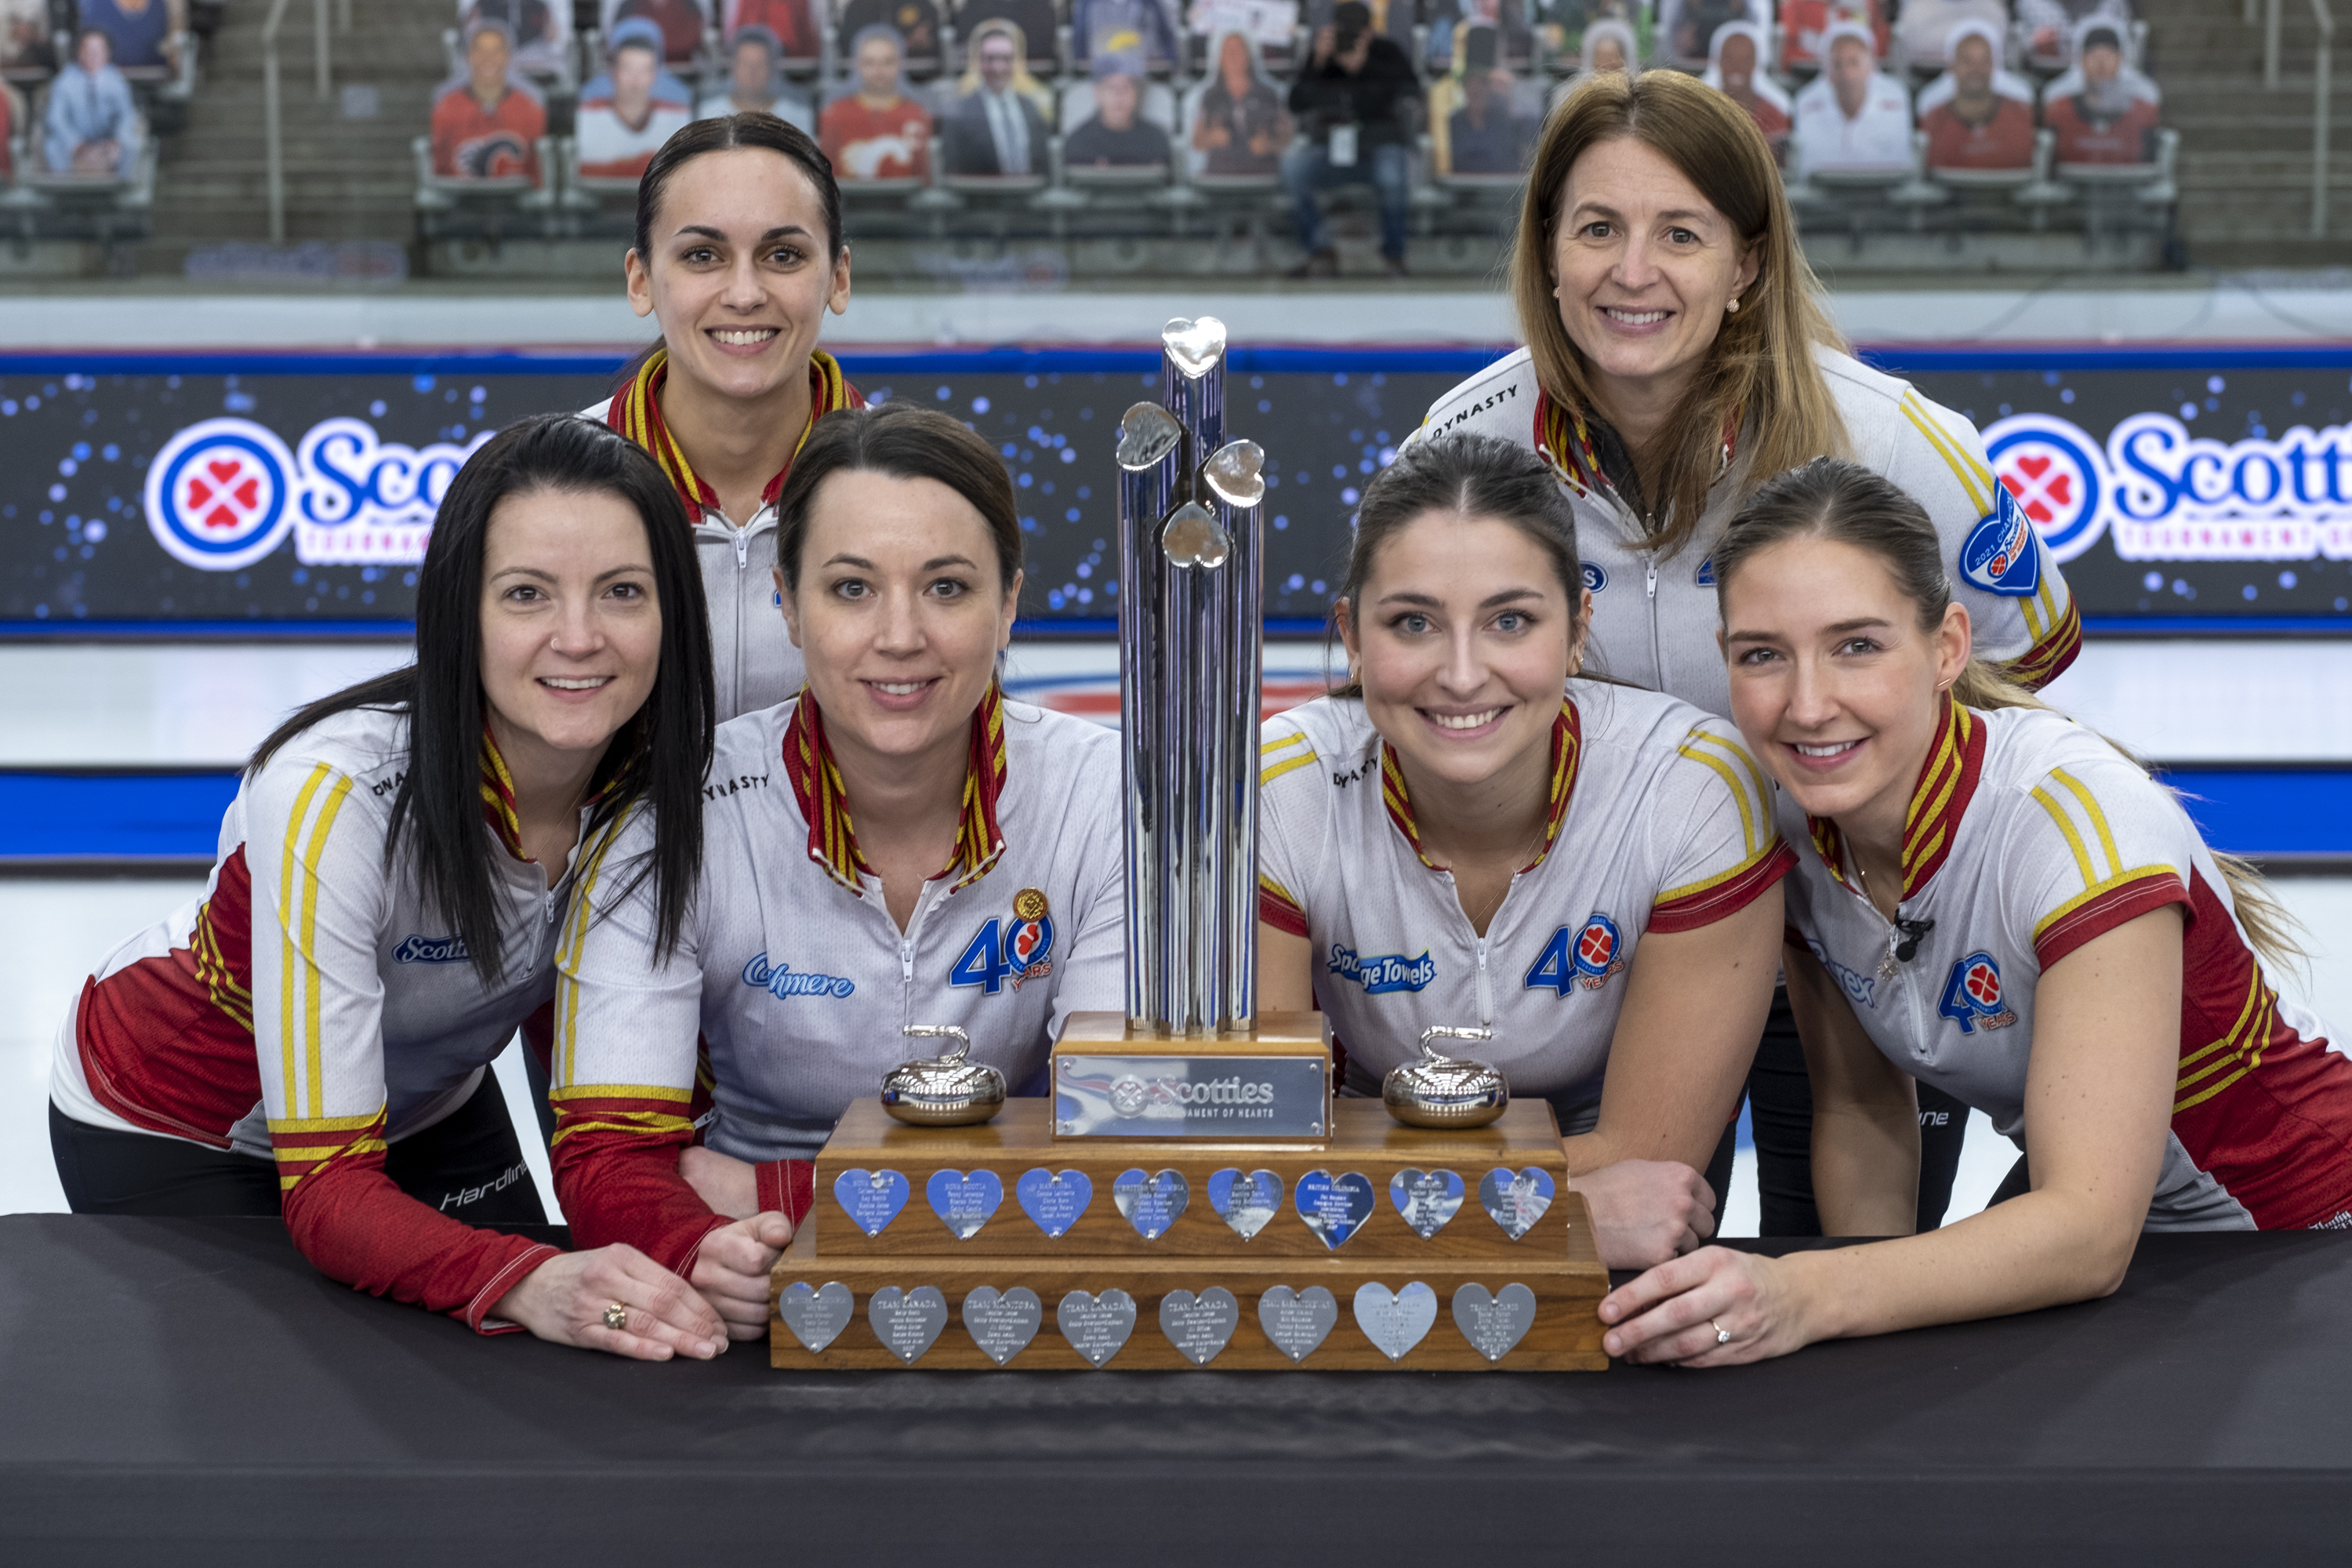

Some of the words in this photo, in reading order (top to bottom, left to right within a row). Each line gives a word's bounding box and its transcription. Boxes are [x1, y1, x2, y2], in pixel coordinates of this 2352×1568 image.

[1433, 383, 1518, 438] DYNASTY
[1976, 545, 1996, 566] 2021
[1156, 1076, 1273, 1106] Scotties
[1222, 1108, 1234, 1118] OF
[1238, 1108, 1274, 1118] HEARTS
[439, 1159, 528, 1211] Hardline
[902, 1299, 938, 1308] CANADA
[1090, 1301, 1125, 1312] CANADA
[1192, 1300, 1229, 1311] CANADA
